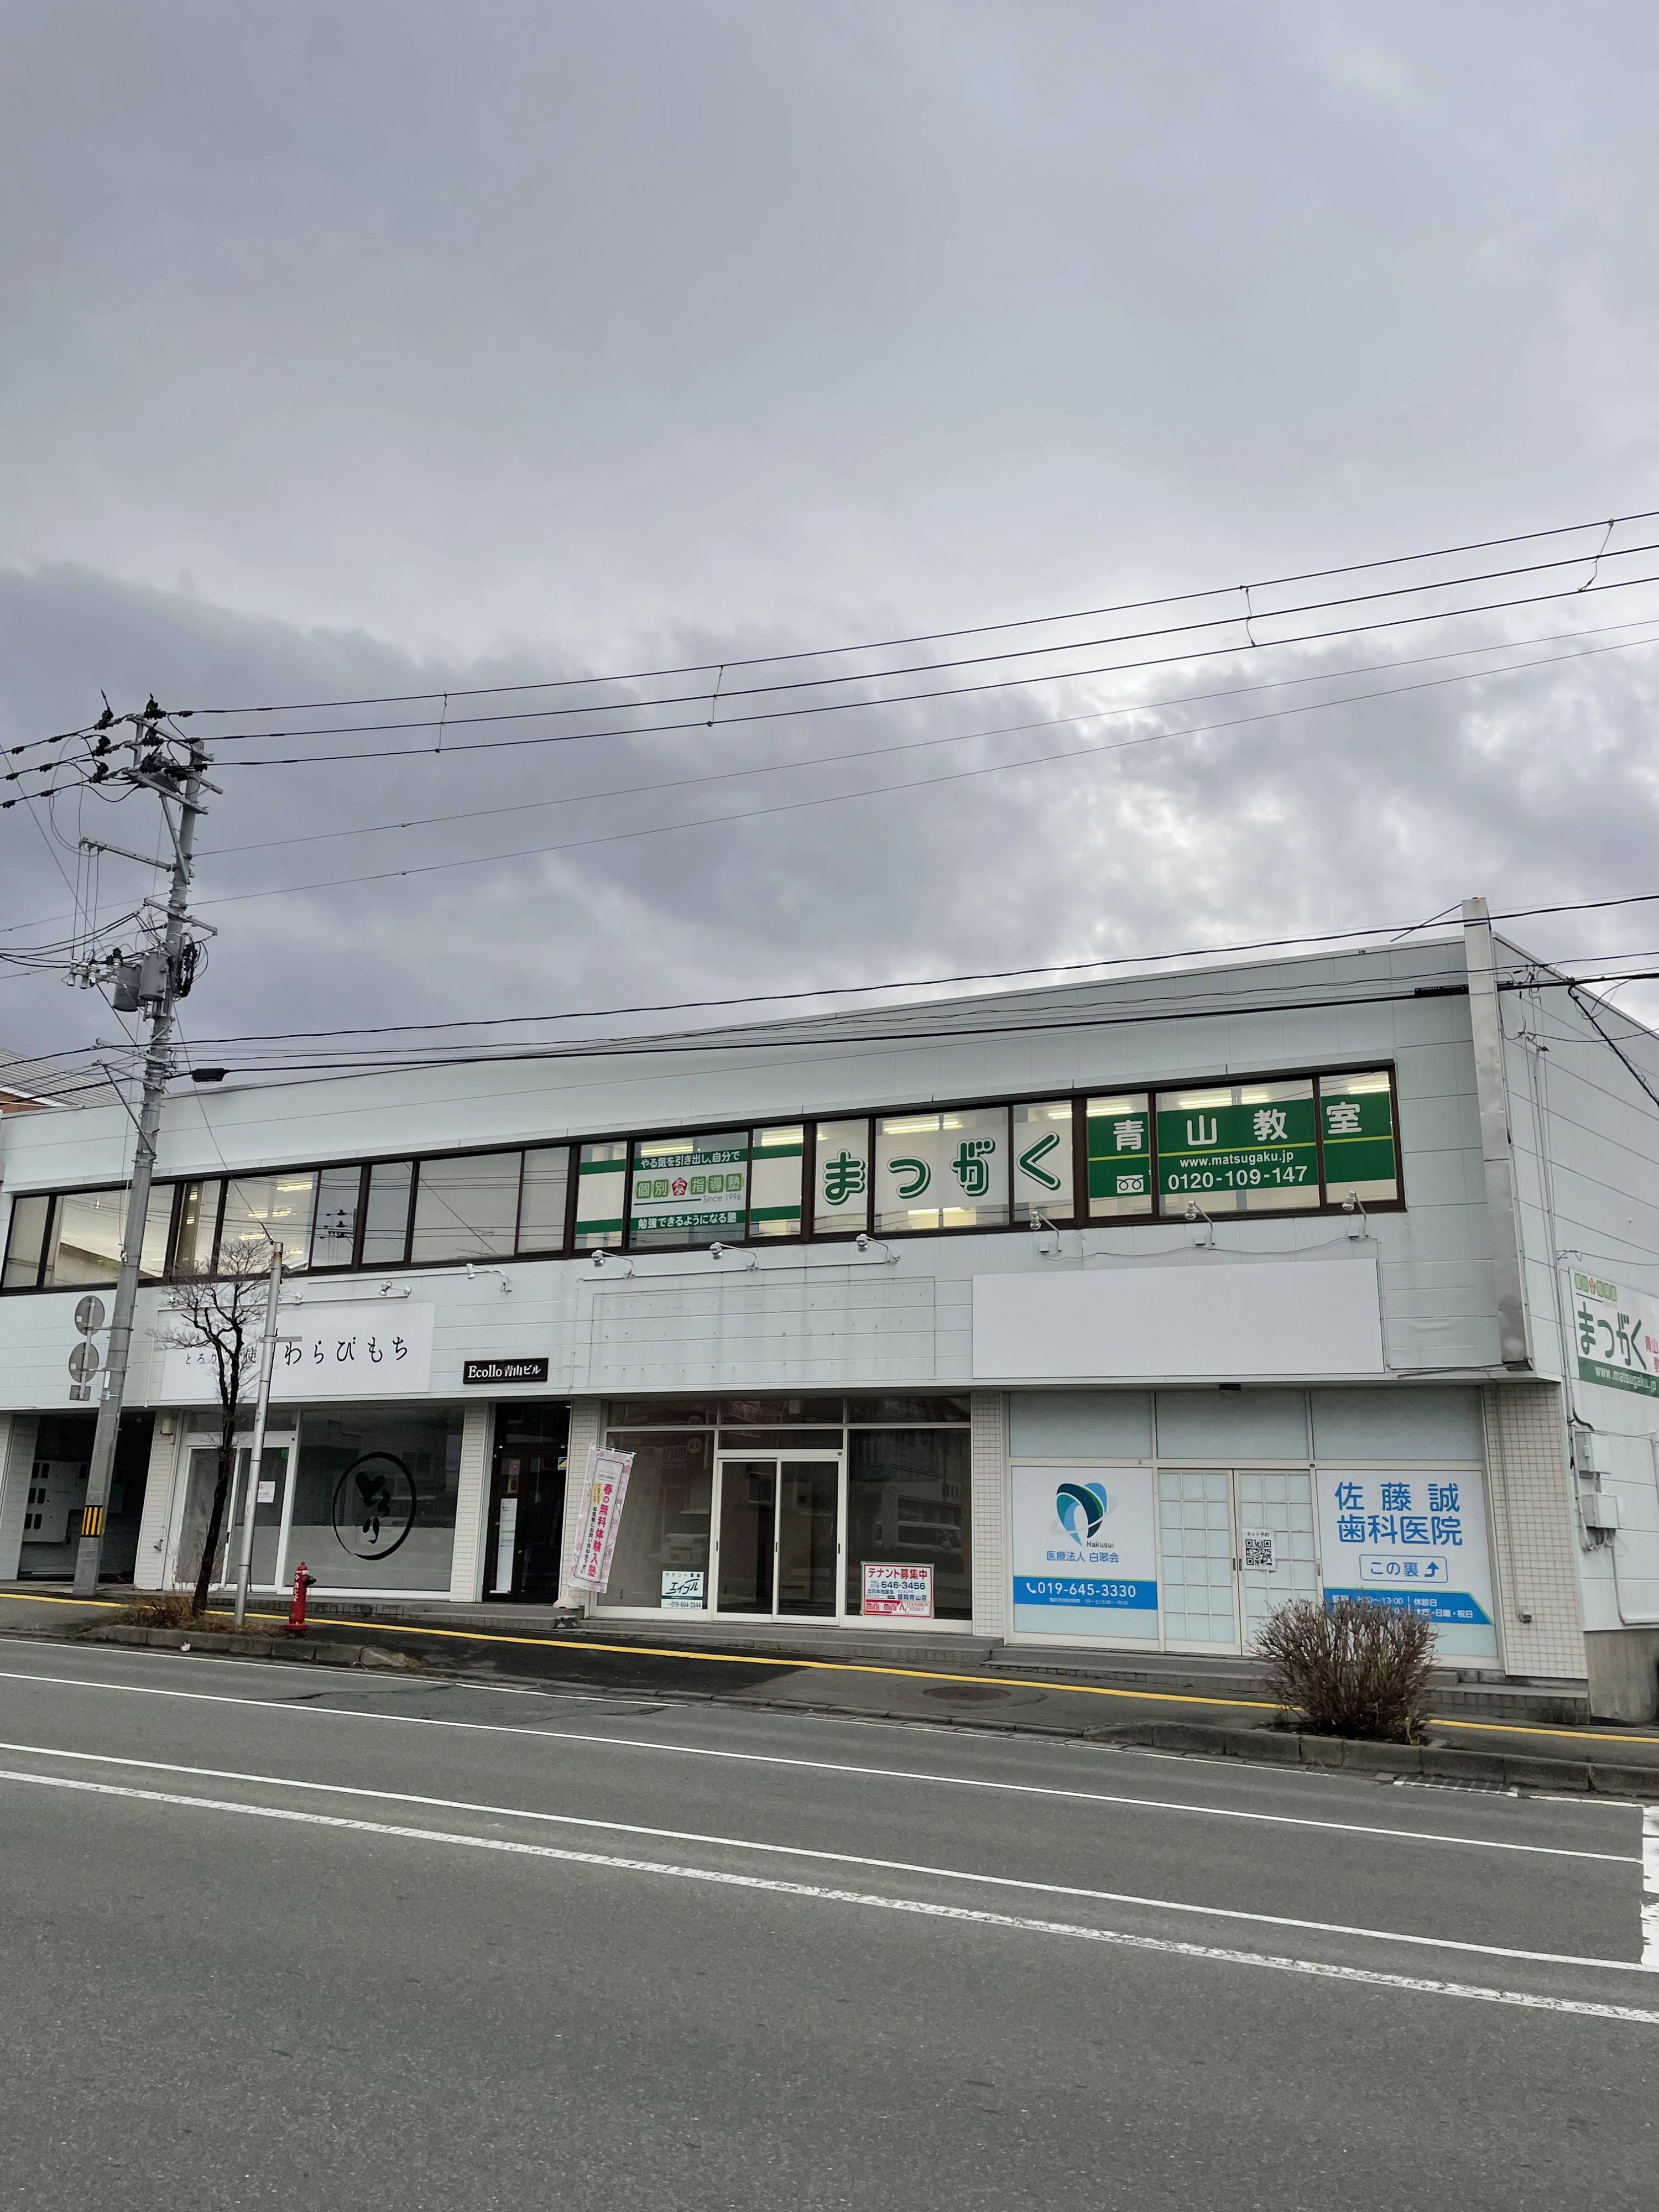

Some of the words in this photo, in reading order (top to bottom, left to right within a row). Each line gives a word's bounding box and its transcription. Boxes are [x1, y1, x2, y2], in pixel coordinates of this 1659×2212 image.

[1113, 1101, 1363, 1151] 青山教室
[640, 1151, 740, 1168] やる気を引き出し、自分で
[1180, 1150, 1294, 1168] www.matsugaku.jp
[823, 1131, 1061, 1206] まつがく
[1167, 1166, 1308, 1191] 0120-109-147
[703, 1194, 722, 1203] Since
[725, 1193, 741, 1202] 1996
[638, 1212, 737, 1229] 勉強できるようになる塾
[1577, 1301, 1647, 1370] まつがく
[285, 1336, 408, 1366] わらびもち
[467, 1364, 503, 1378] Ecollo
[1334, 1482, 1460, 1512] 佐藤誠
[1337, 1514, 1463, 1546] 歯科医院
[1047, 1551, 1086, 1562] 医療法人
[868, 1568, 927, 1580] テナント募集中
[1370, 1562, 1420, 1577] この裏
[1037, 1582, 1136, 1598] 019-645-3330
